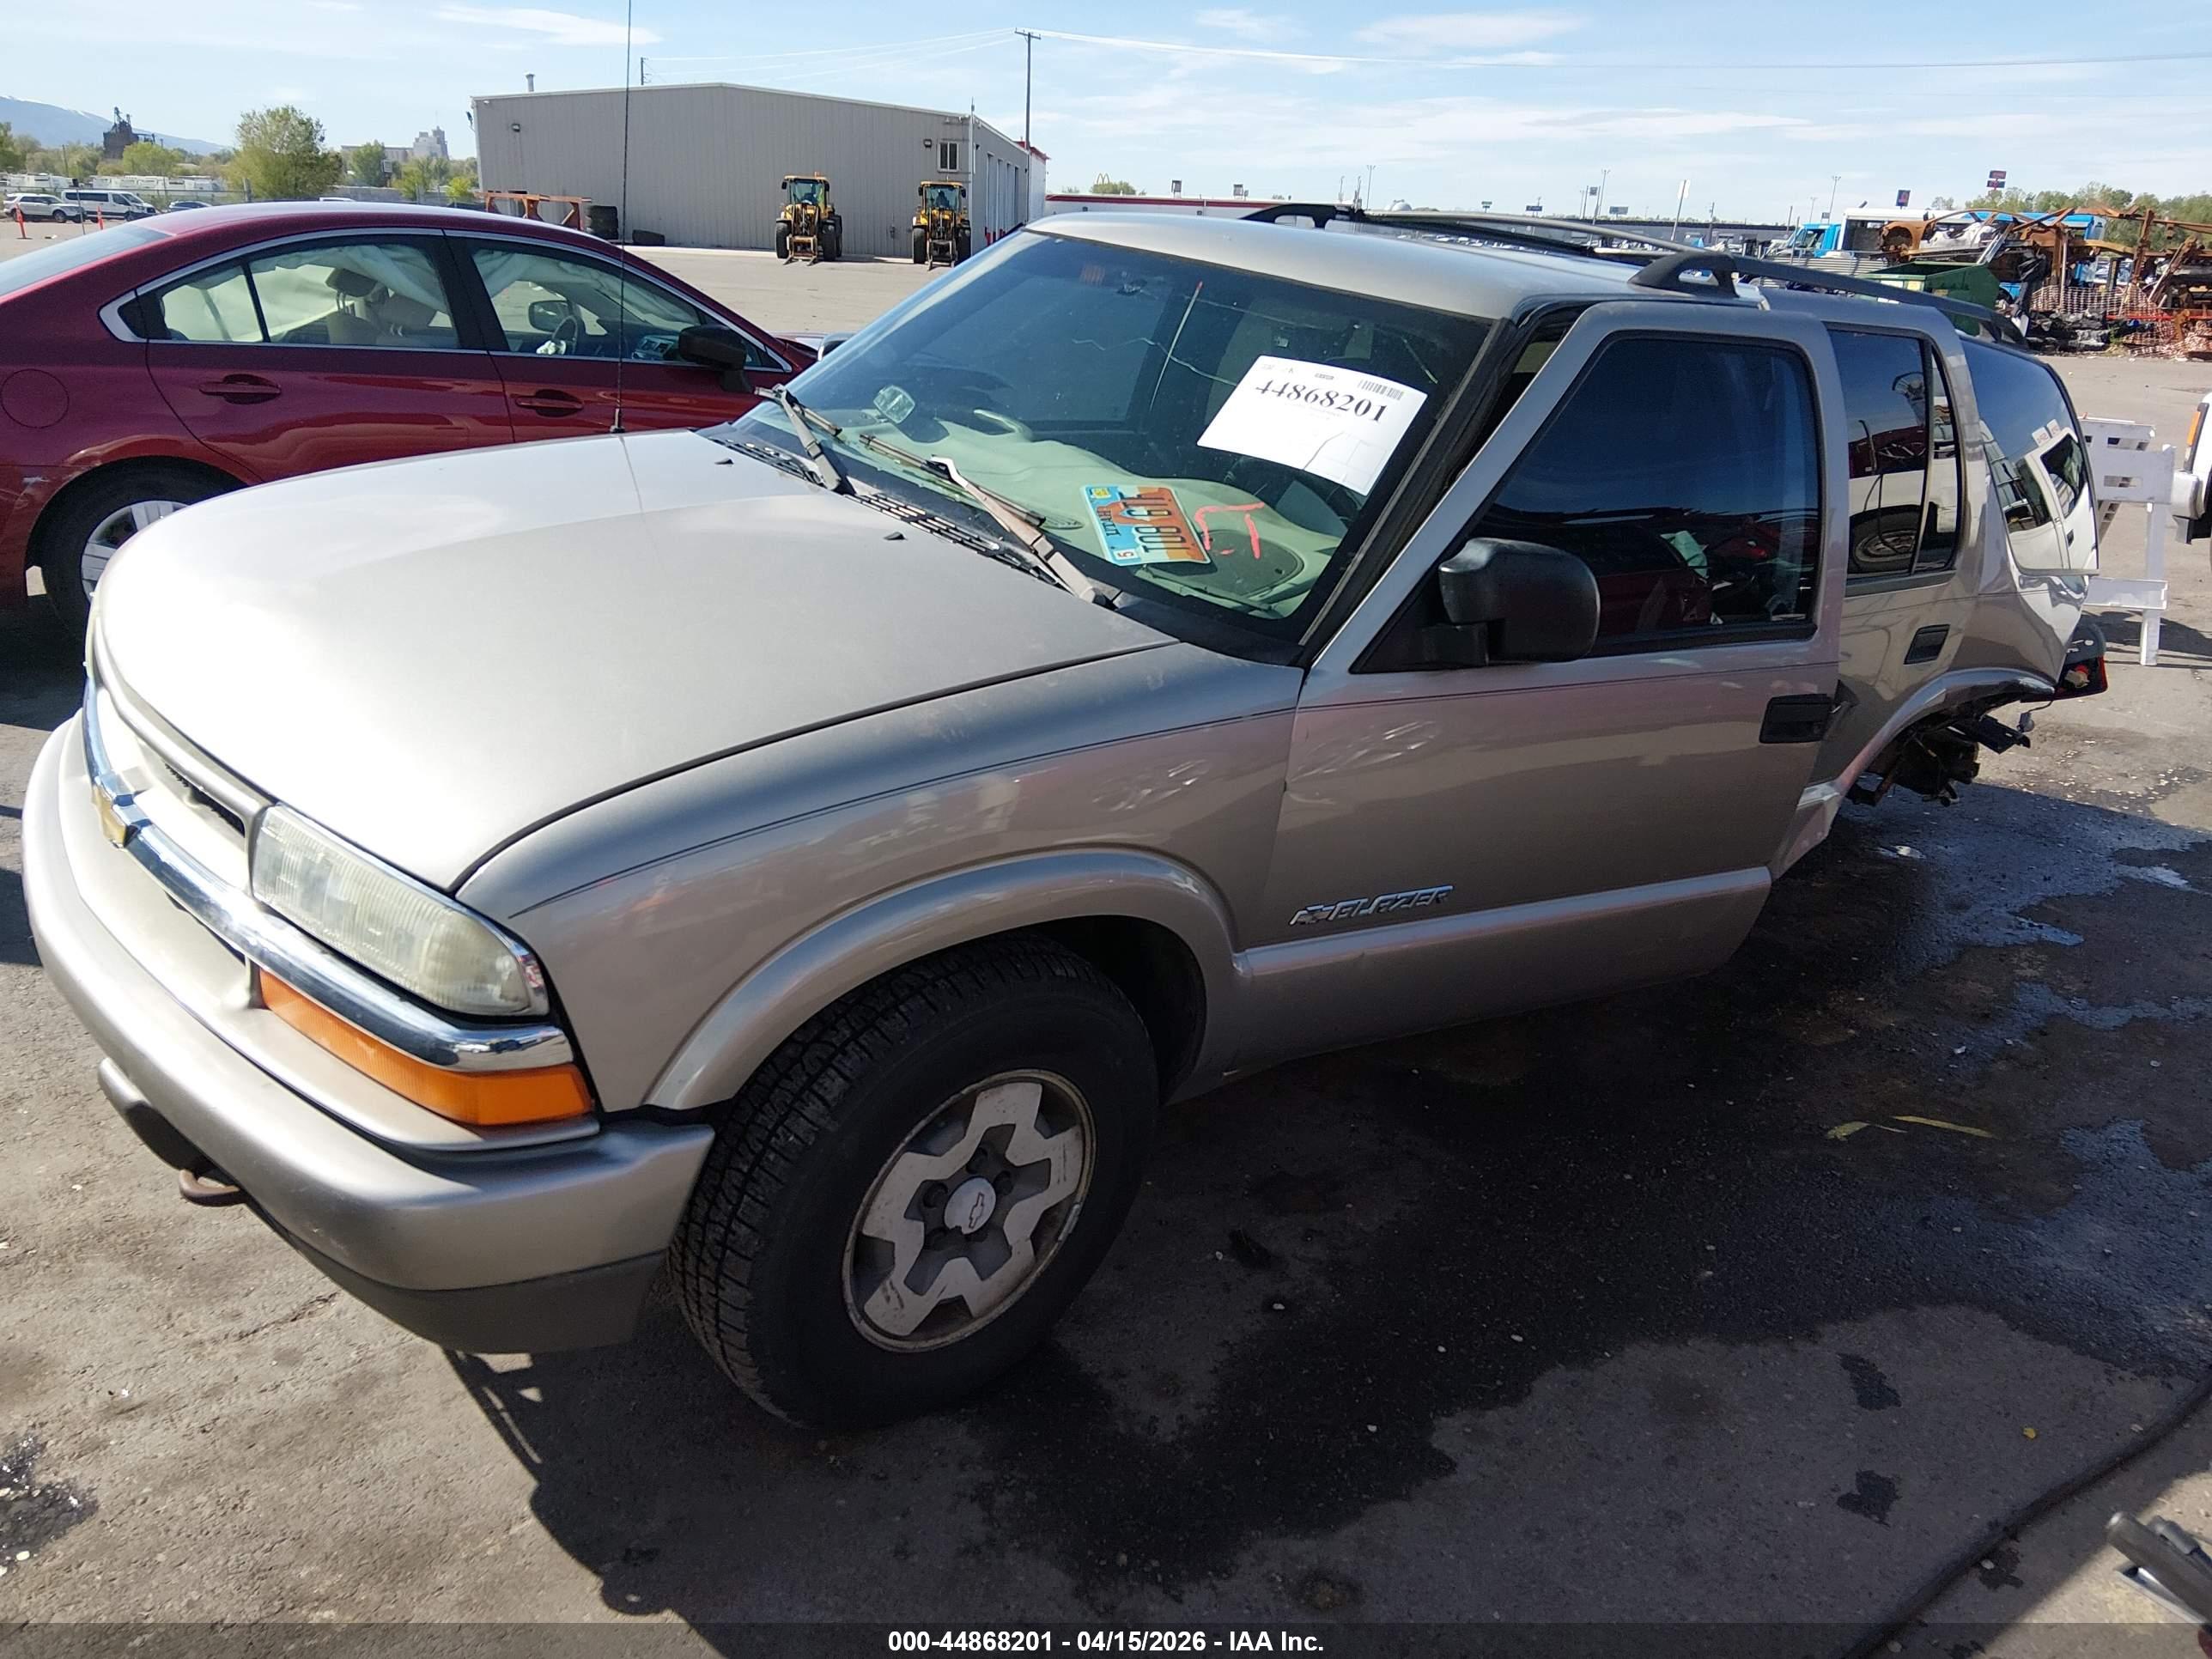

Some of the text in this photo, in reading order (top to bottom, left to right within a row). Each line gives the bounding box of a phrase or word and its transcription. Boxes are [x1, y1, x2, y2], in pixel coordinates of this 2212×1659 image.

[1255, 380, 1389, 423] 44868201
[1097, 506, 1121, 537] UTAH
[1328, 884, 1455, 921] BLAZER
